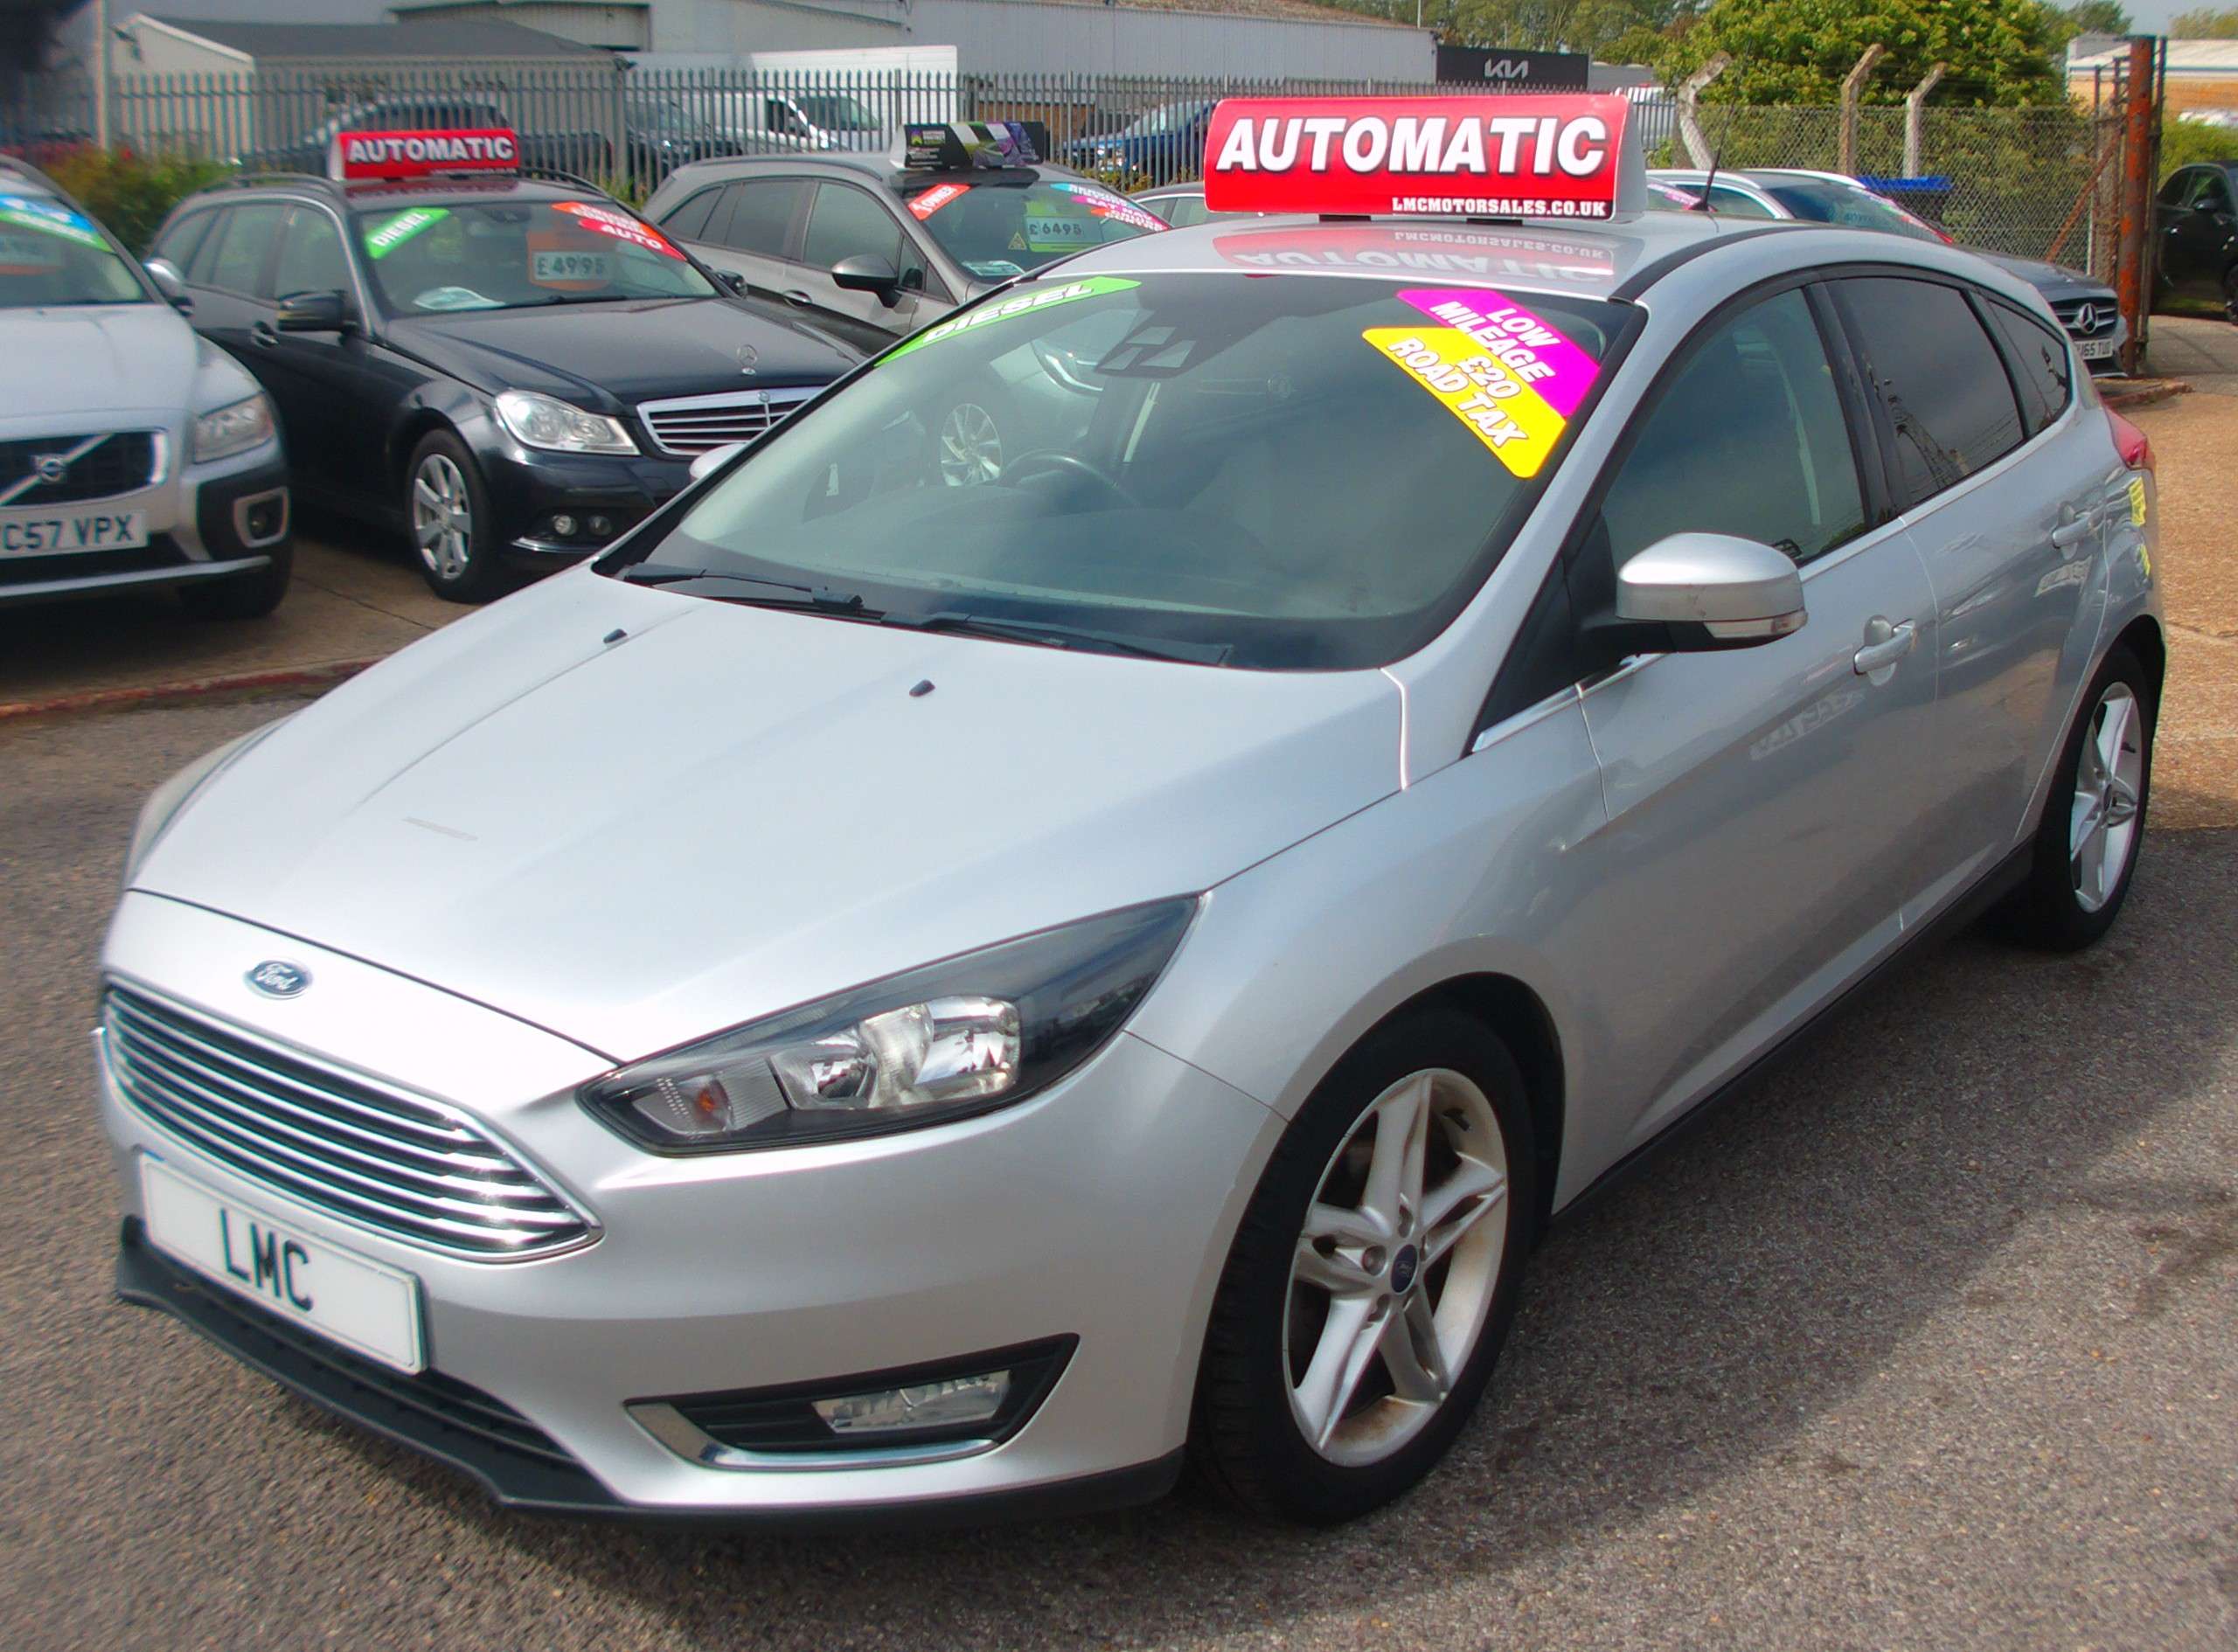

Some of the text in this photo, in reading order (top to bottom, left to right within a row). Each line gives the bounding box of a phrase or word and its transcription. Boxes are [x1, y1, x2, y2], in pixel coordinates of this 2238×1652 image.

[350, 136, 514, 163] AUTOMATIC
[1215, 116, 1607, 175] AUTOMATIC
[1393, 198, 1606, 218] LMCMOTORSALES.CO.UK
[601, 225, 663, 250] AUTO
[923, 284, 1094, 344] DIESEL
[1486, 308, 1561, 348] LOW
[1429, 301, 1556, 383] MILEAGE
[1387, 337, 1529, 448] ROAD TAX
[1456, 356, 1521, 399] £20
[73, 514, 133, 545] VPX
[219, 1207, 313, 1312] LMC
